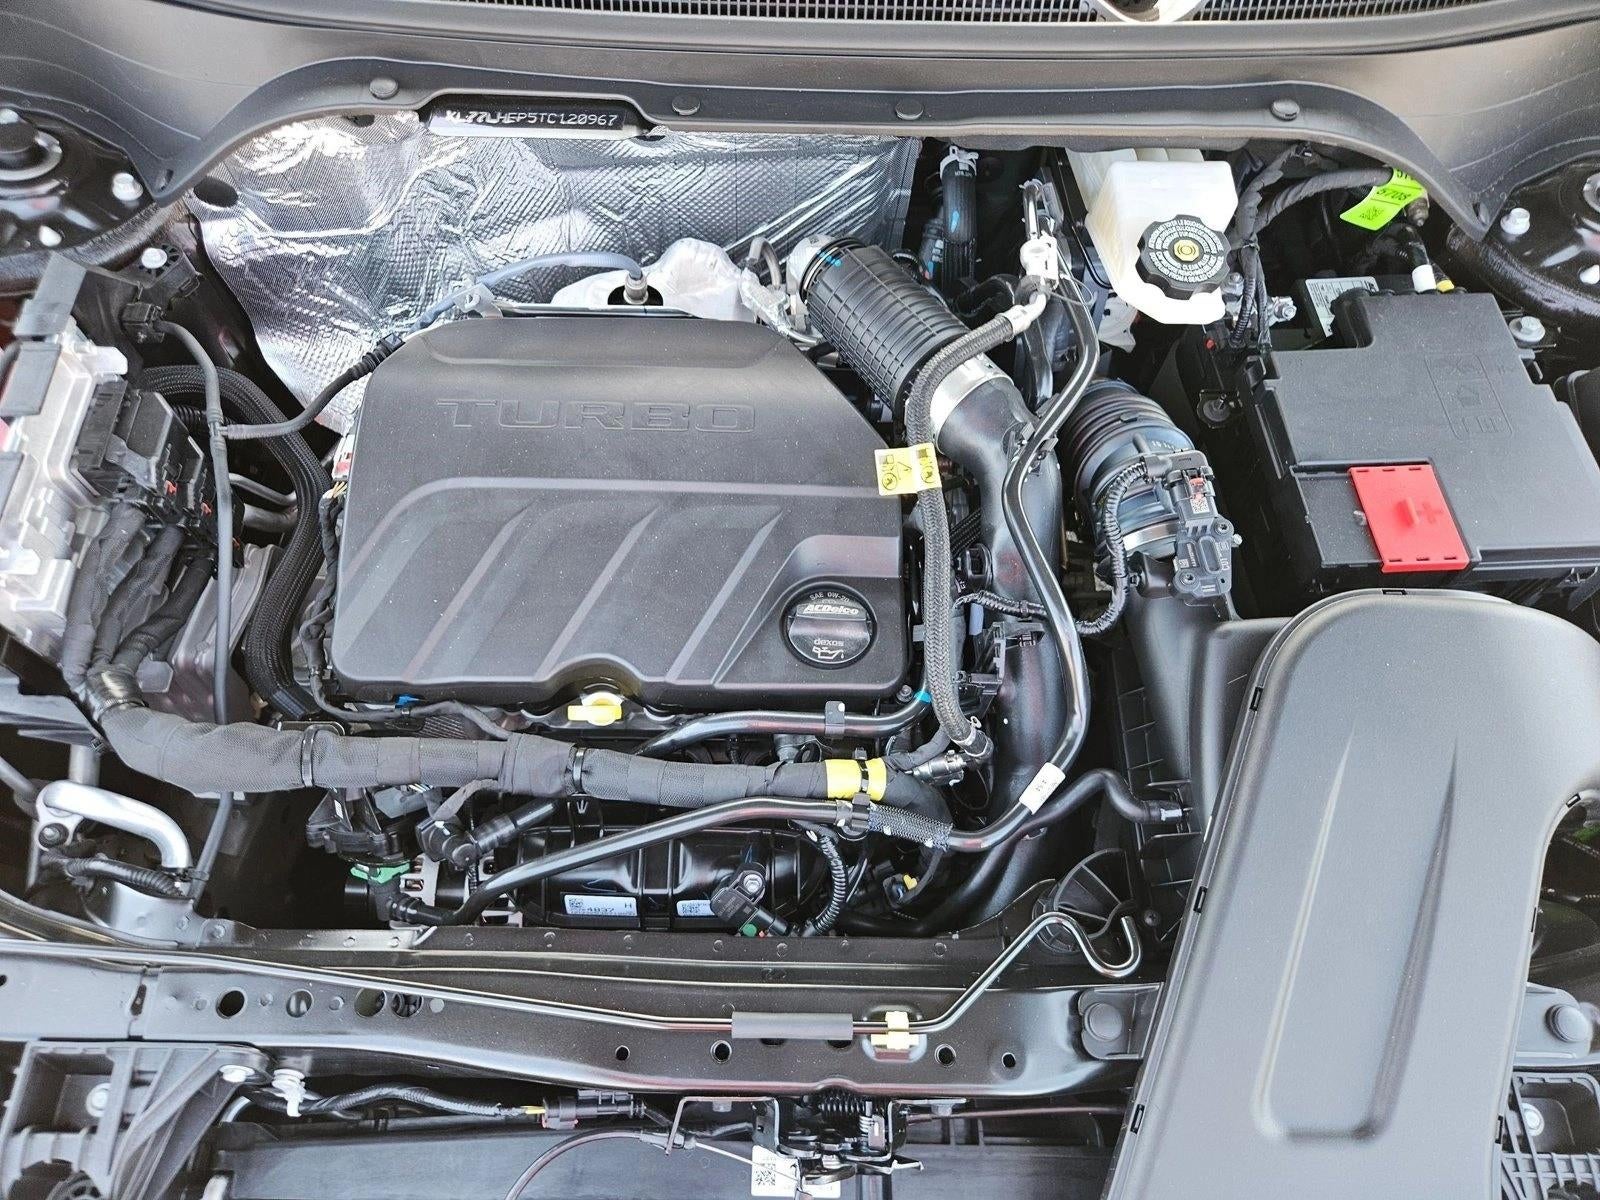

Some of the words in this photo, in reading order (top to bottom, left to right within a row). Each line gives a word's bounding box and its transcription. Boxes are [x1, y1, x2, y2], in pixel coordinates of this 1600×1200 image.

[437, 399, 755, 431] TURBO
[809, 592, 824, 601] SAE
[827, 591, 850, 603] 0W-20
[803, 604, 859, 615] ACDelco
[814, 638, 844, 646] dexos
